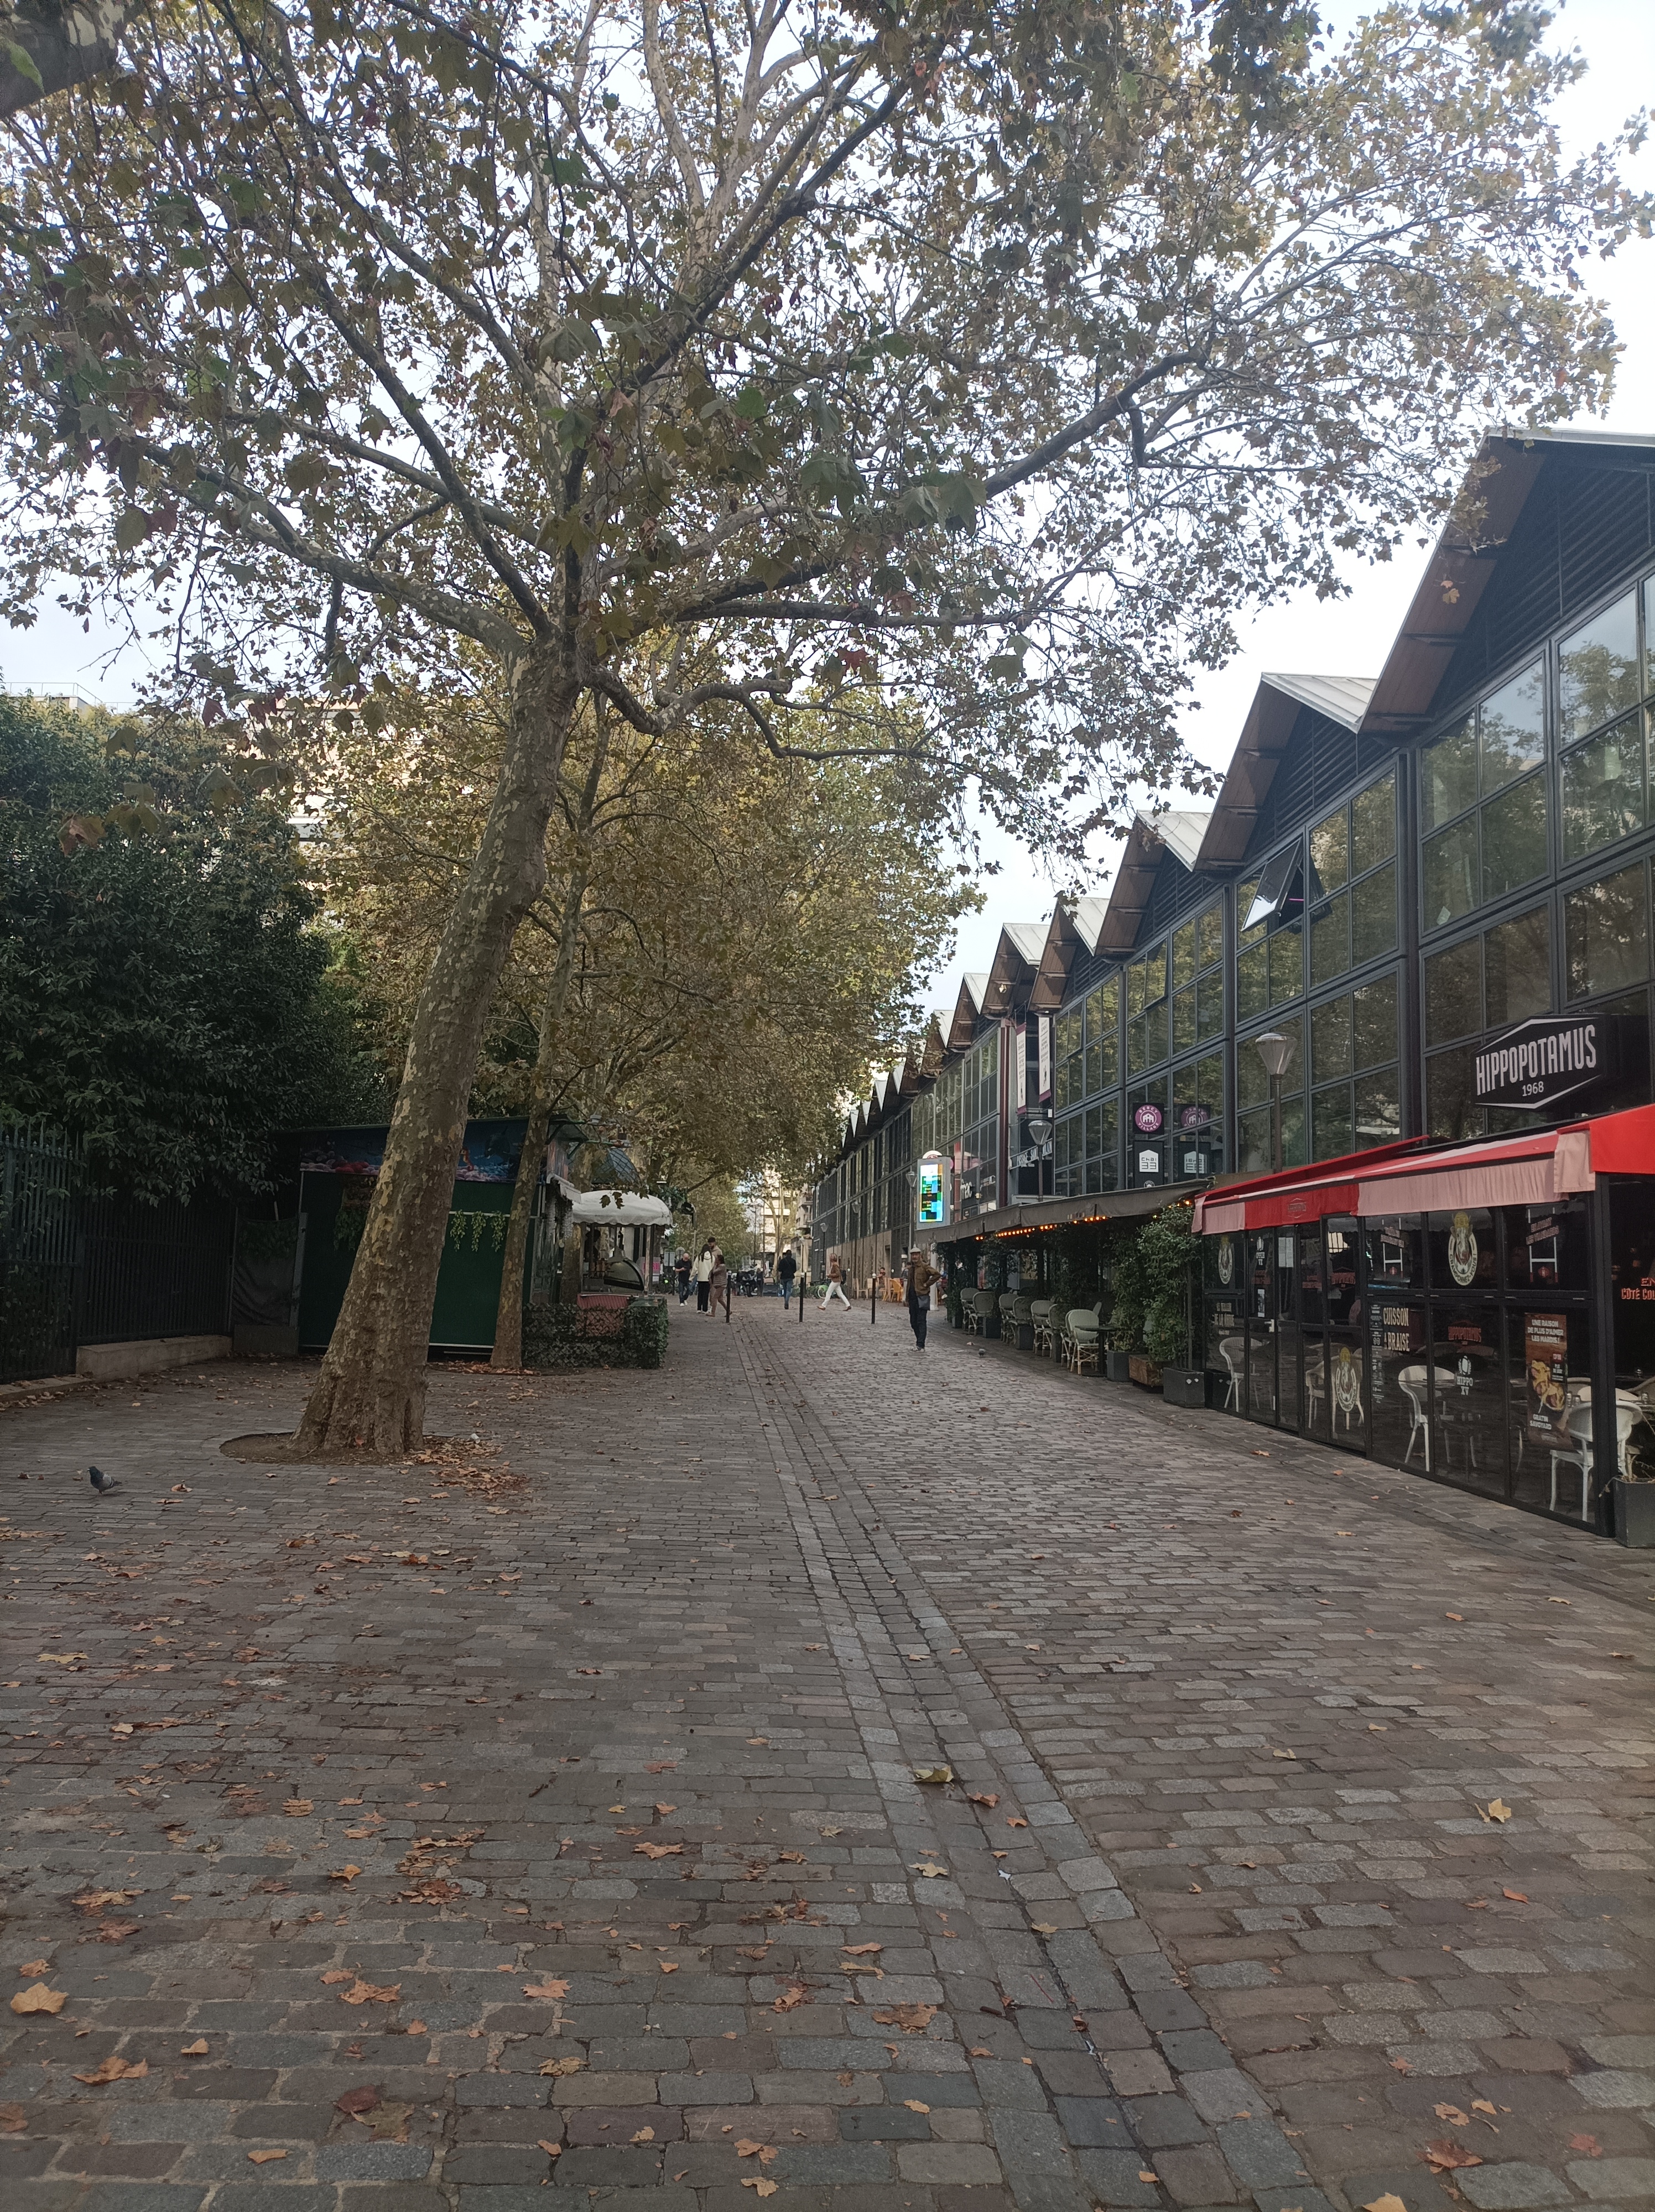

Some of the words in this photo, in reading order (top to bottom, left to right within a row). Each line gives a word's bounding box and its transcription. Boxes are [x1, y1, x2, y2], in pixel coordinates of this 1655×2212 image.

[1476, 1025, 1596, 1095] HIPPOPOTAMUS
[1522, 1081, 1544, 1096] 1968
[1138, 1122, 1159, 1131] VILLAGE
[1383, 1307, 1409, 1326] CUISSON
[1387, 1332, 1410, 1352] BRAISE
[1456, 1376, 1474, 1386] HIPPO
[1460, 1386, 1470, 1396] XV
